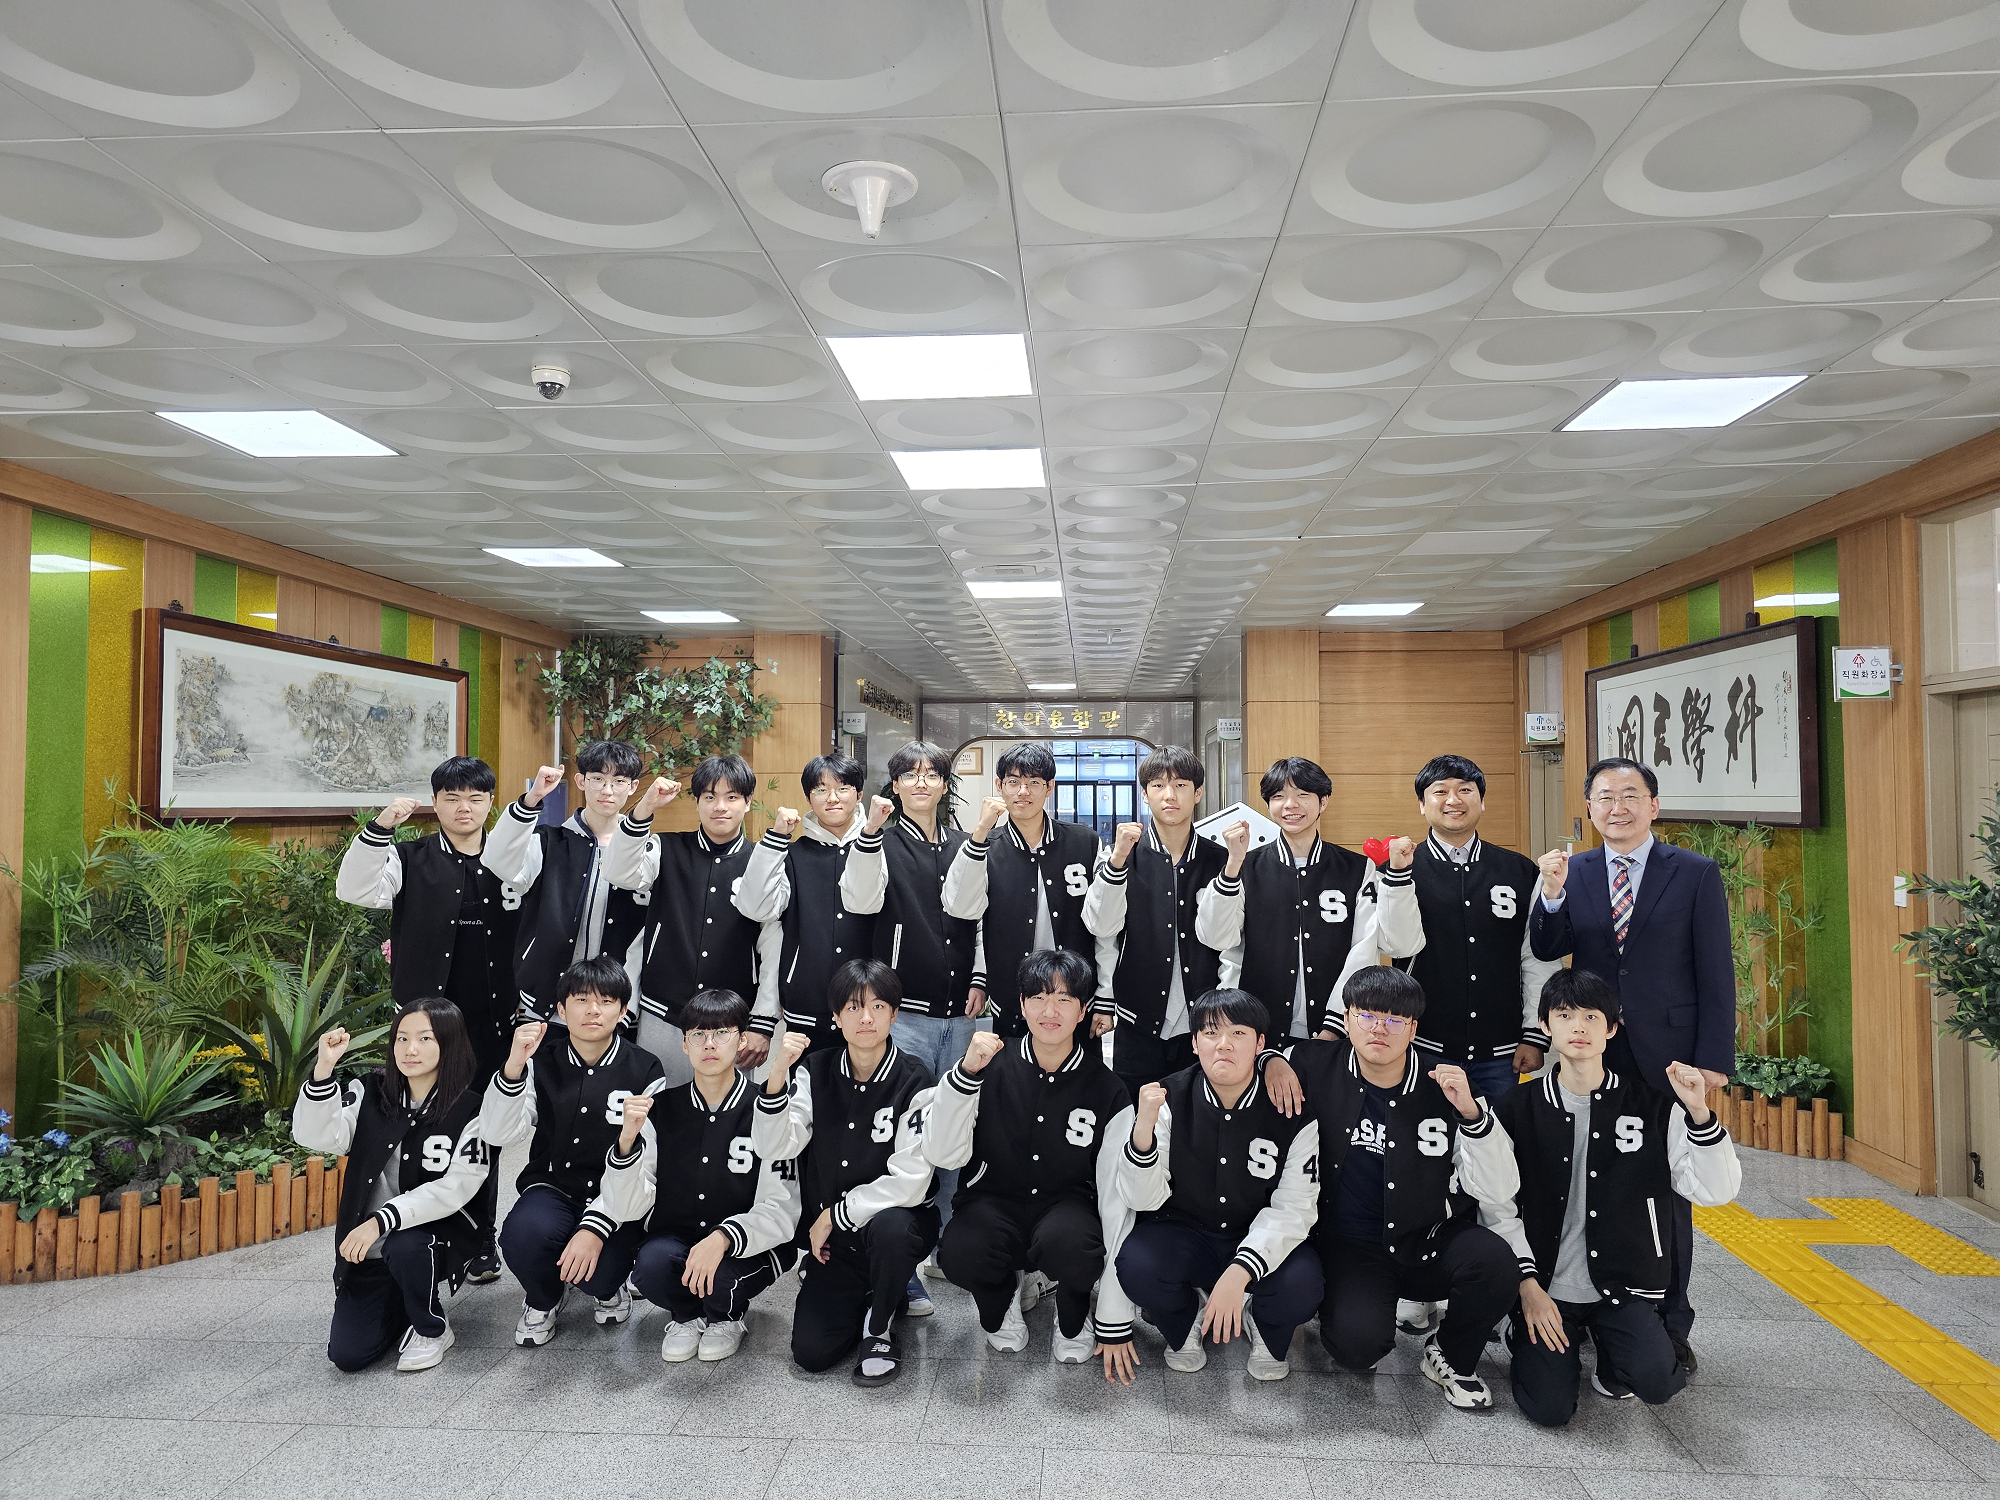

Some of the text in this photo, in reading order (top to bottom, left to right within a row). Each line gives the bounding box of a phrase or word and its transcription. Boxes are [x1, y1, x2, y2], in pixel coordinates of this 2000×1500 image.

[1842, 670, 1887, 680] 직원화장실
[501, 881, 522, 911] S
[1063, 862, 1089, 897] S
[1318, 889, 1348, 923] S
[1489, 885, 1517, 919] S
[870, 1106, 894, 1143] S
[1065, 1108, 1097, 1147] S
[1417, 1117, 1449, 1156] S
[1614, 1115, 1644, 1153] S
[421, 1134, 452, 1172] S
[460, 1137, 489, 1165] 41
[727, 1136, 754, 1174] S
[1247, 1137, 1279, 1180] S
[771, 1159, 797, 1181] 41
